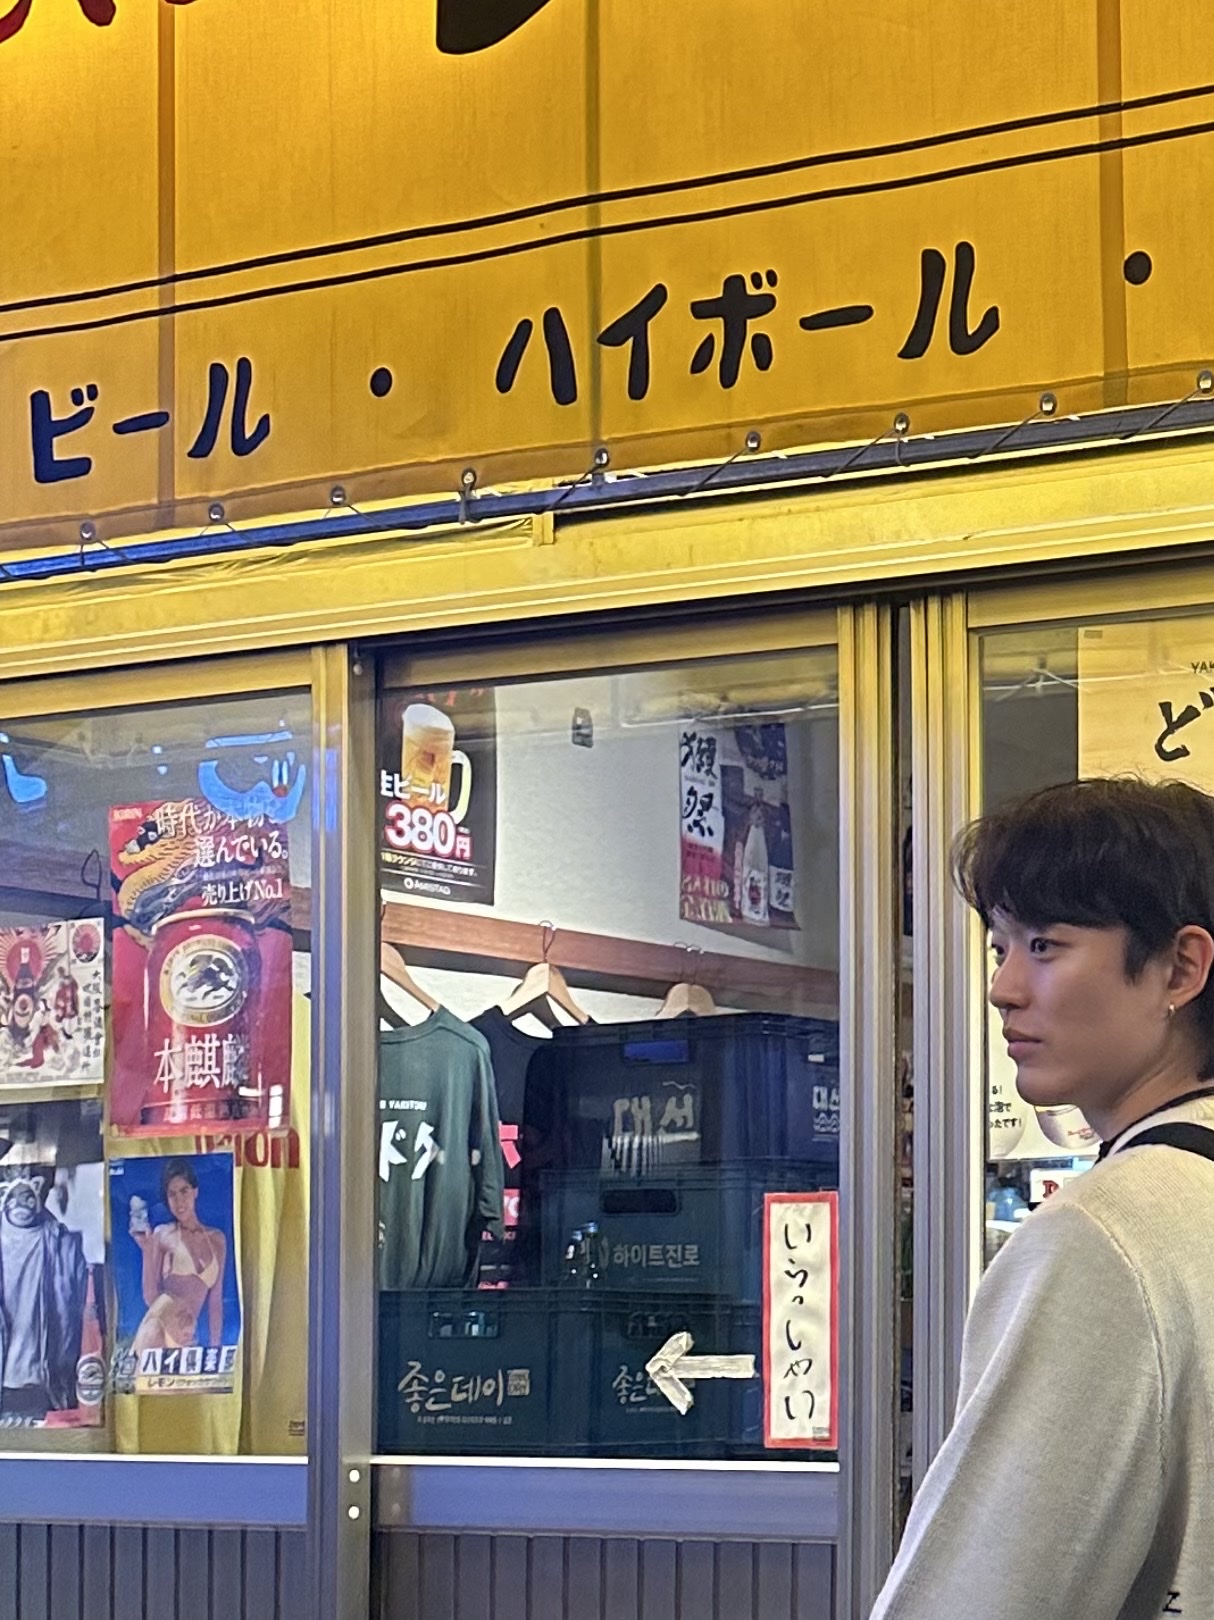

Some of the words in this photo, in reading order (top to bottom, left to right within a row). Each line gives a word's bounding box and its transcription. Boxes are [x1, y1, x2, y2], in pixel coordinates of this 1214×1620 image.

[31, 356, 270, 485] ビール
[495, 241, 1000, 407] ハイボール
[193, 829, 288, 869] 選んでいる。
[613, 1244, 700, 1269] 하이트진로
[783, 1223, 817, 1421] いらっしゃい
[398, 1361, 504, 1413] 좋은데이
